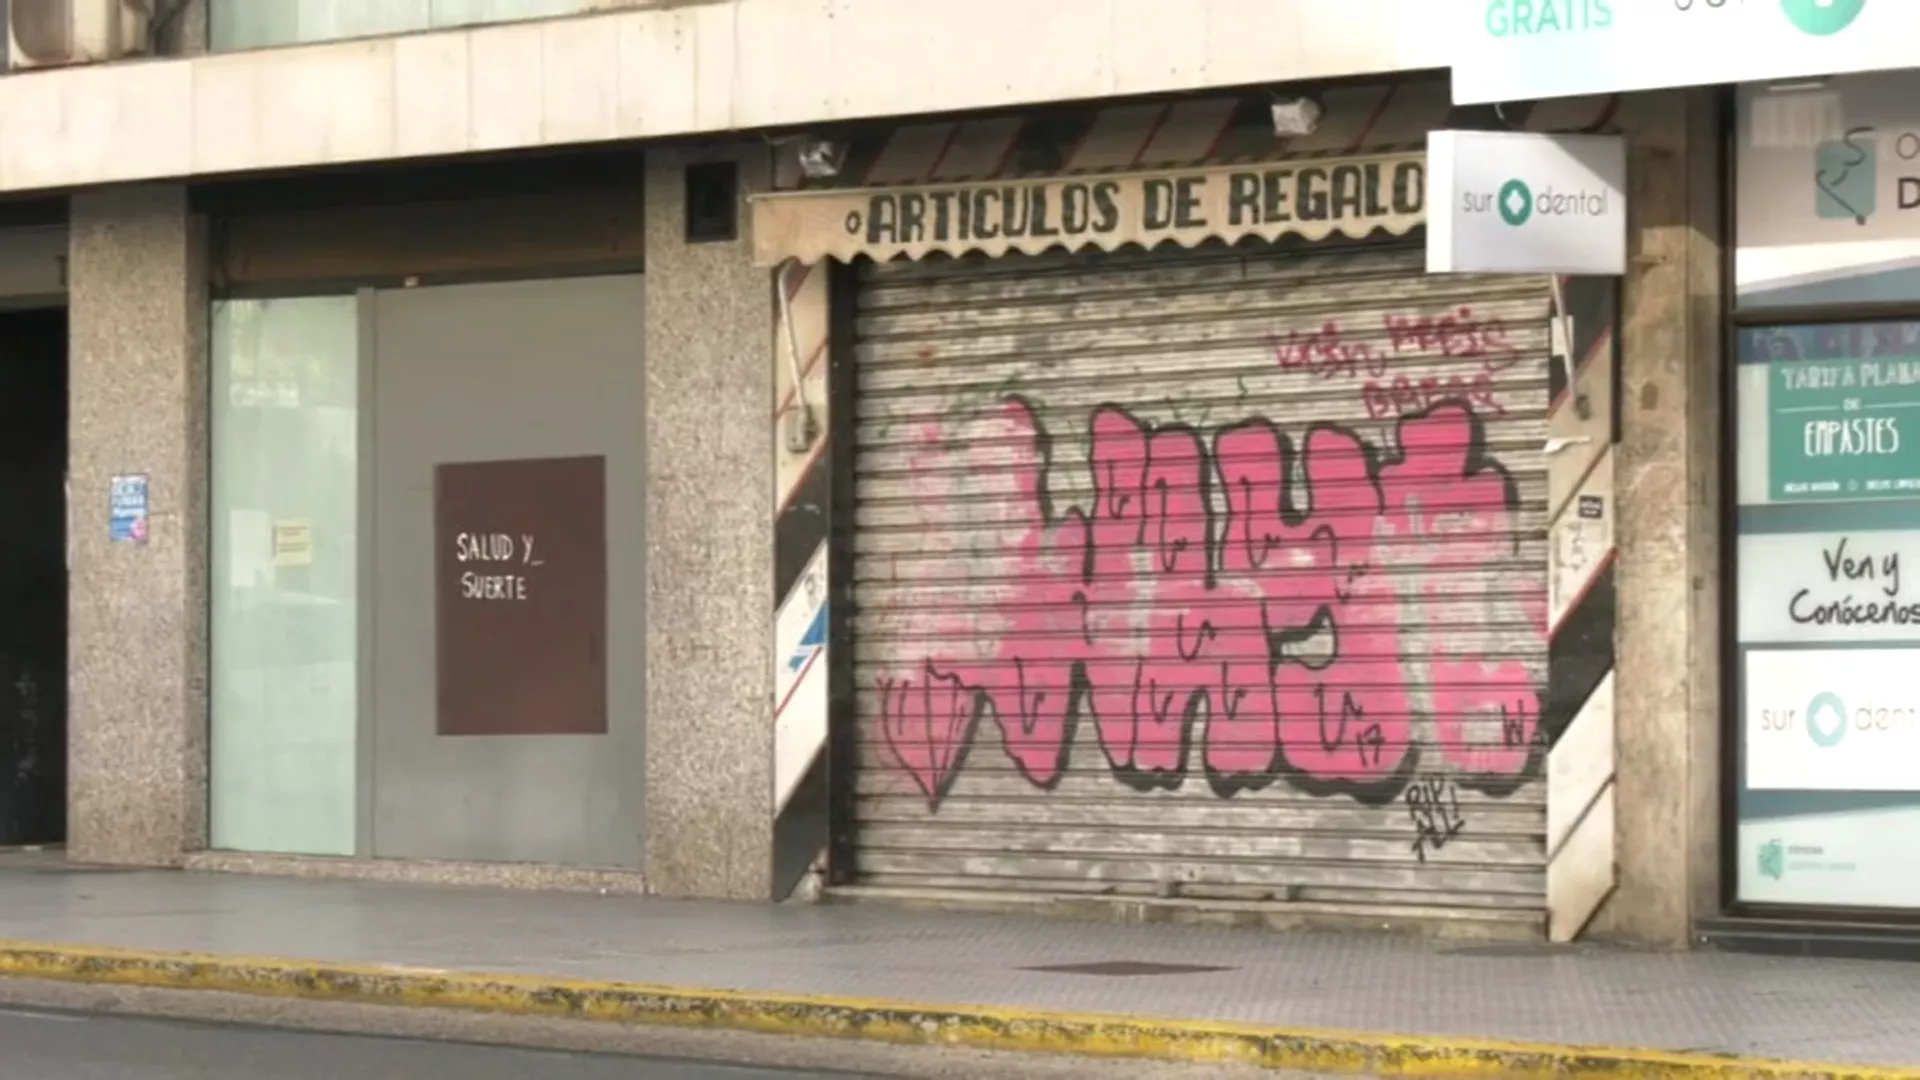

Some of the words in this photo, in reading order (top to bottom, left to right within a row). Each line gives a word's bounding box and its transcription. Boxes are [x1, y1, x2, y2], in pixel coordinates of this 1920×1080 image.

[1485, 0, 1613, 37] GRATIS
[866, 181, 1120, 243] ARTICULOS
[1142, 176, 1207, 230] DE
[1228, 161, 1424, 225] REGALO
[1463, 191, 1493, 213] sur
[1536, 185, 1608, 216] dental
[1804, 417, 1900, 456] EMPASTES
[456, 532, 514, 562] SALUD
[1822, 537, 1875, 581] Ven
[1882, 552, 1899, 597] y
[461, 571, 527, 600] SUERTE
[1761, 707, 1797, 731] sur
